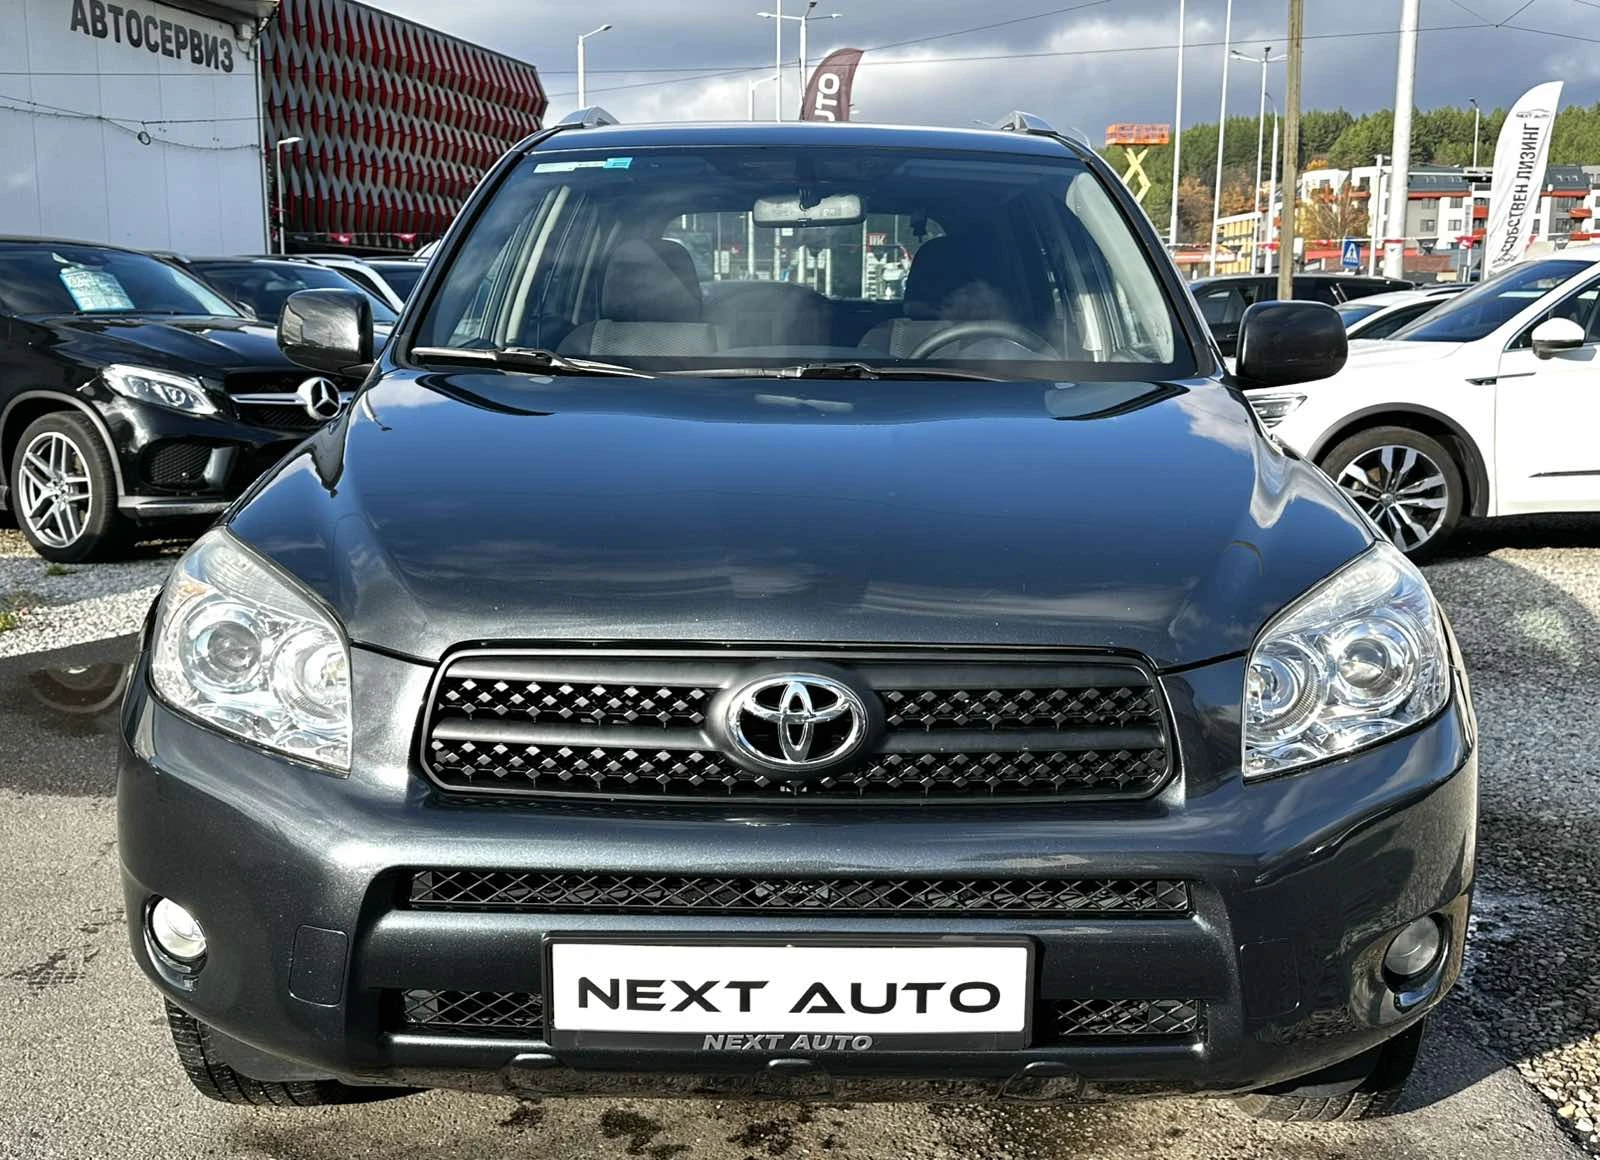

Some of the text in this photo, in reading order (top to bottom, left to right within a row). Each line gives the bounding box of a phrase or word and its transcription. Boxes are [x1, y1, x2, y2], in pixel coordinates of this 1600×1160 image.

[71, 0, 234, 73] АВТОСЕРВИЗ
[1517, 123, 1540, 181] ЛИЗИНГ
[578, 976, 1001, 1014] NEXT AUTO
[702, 1034, 873, 1051] NEXT AUTO
